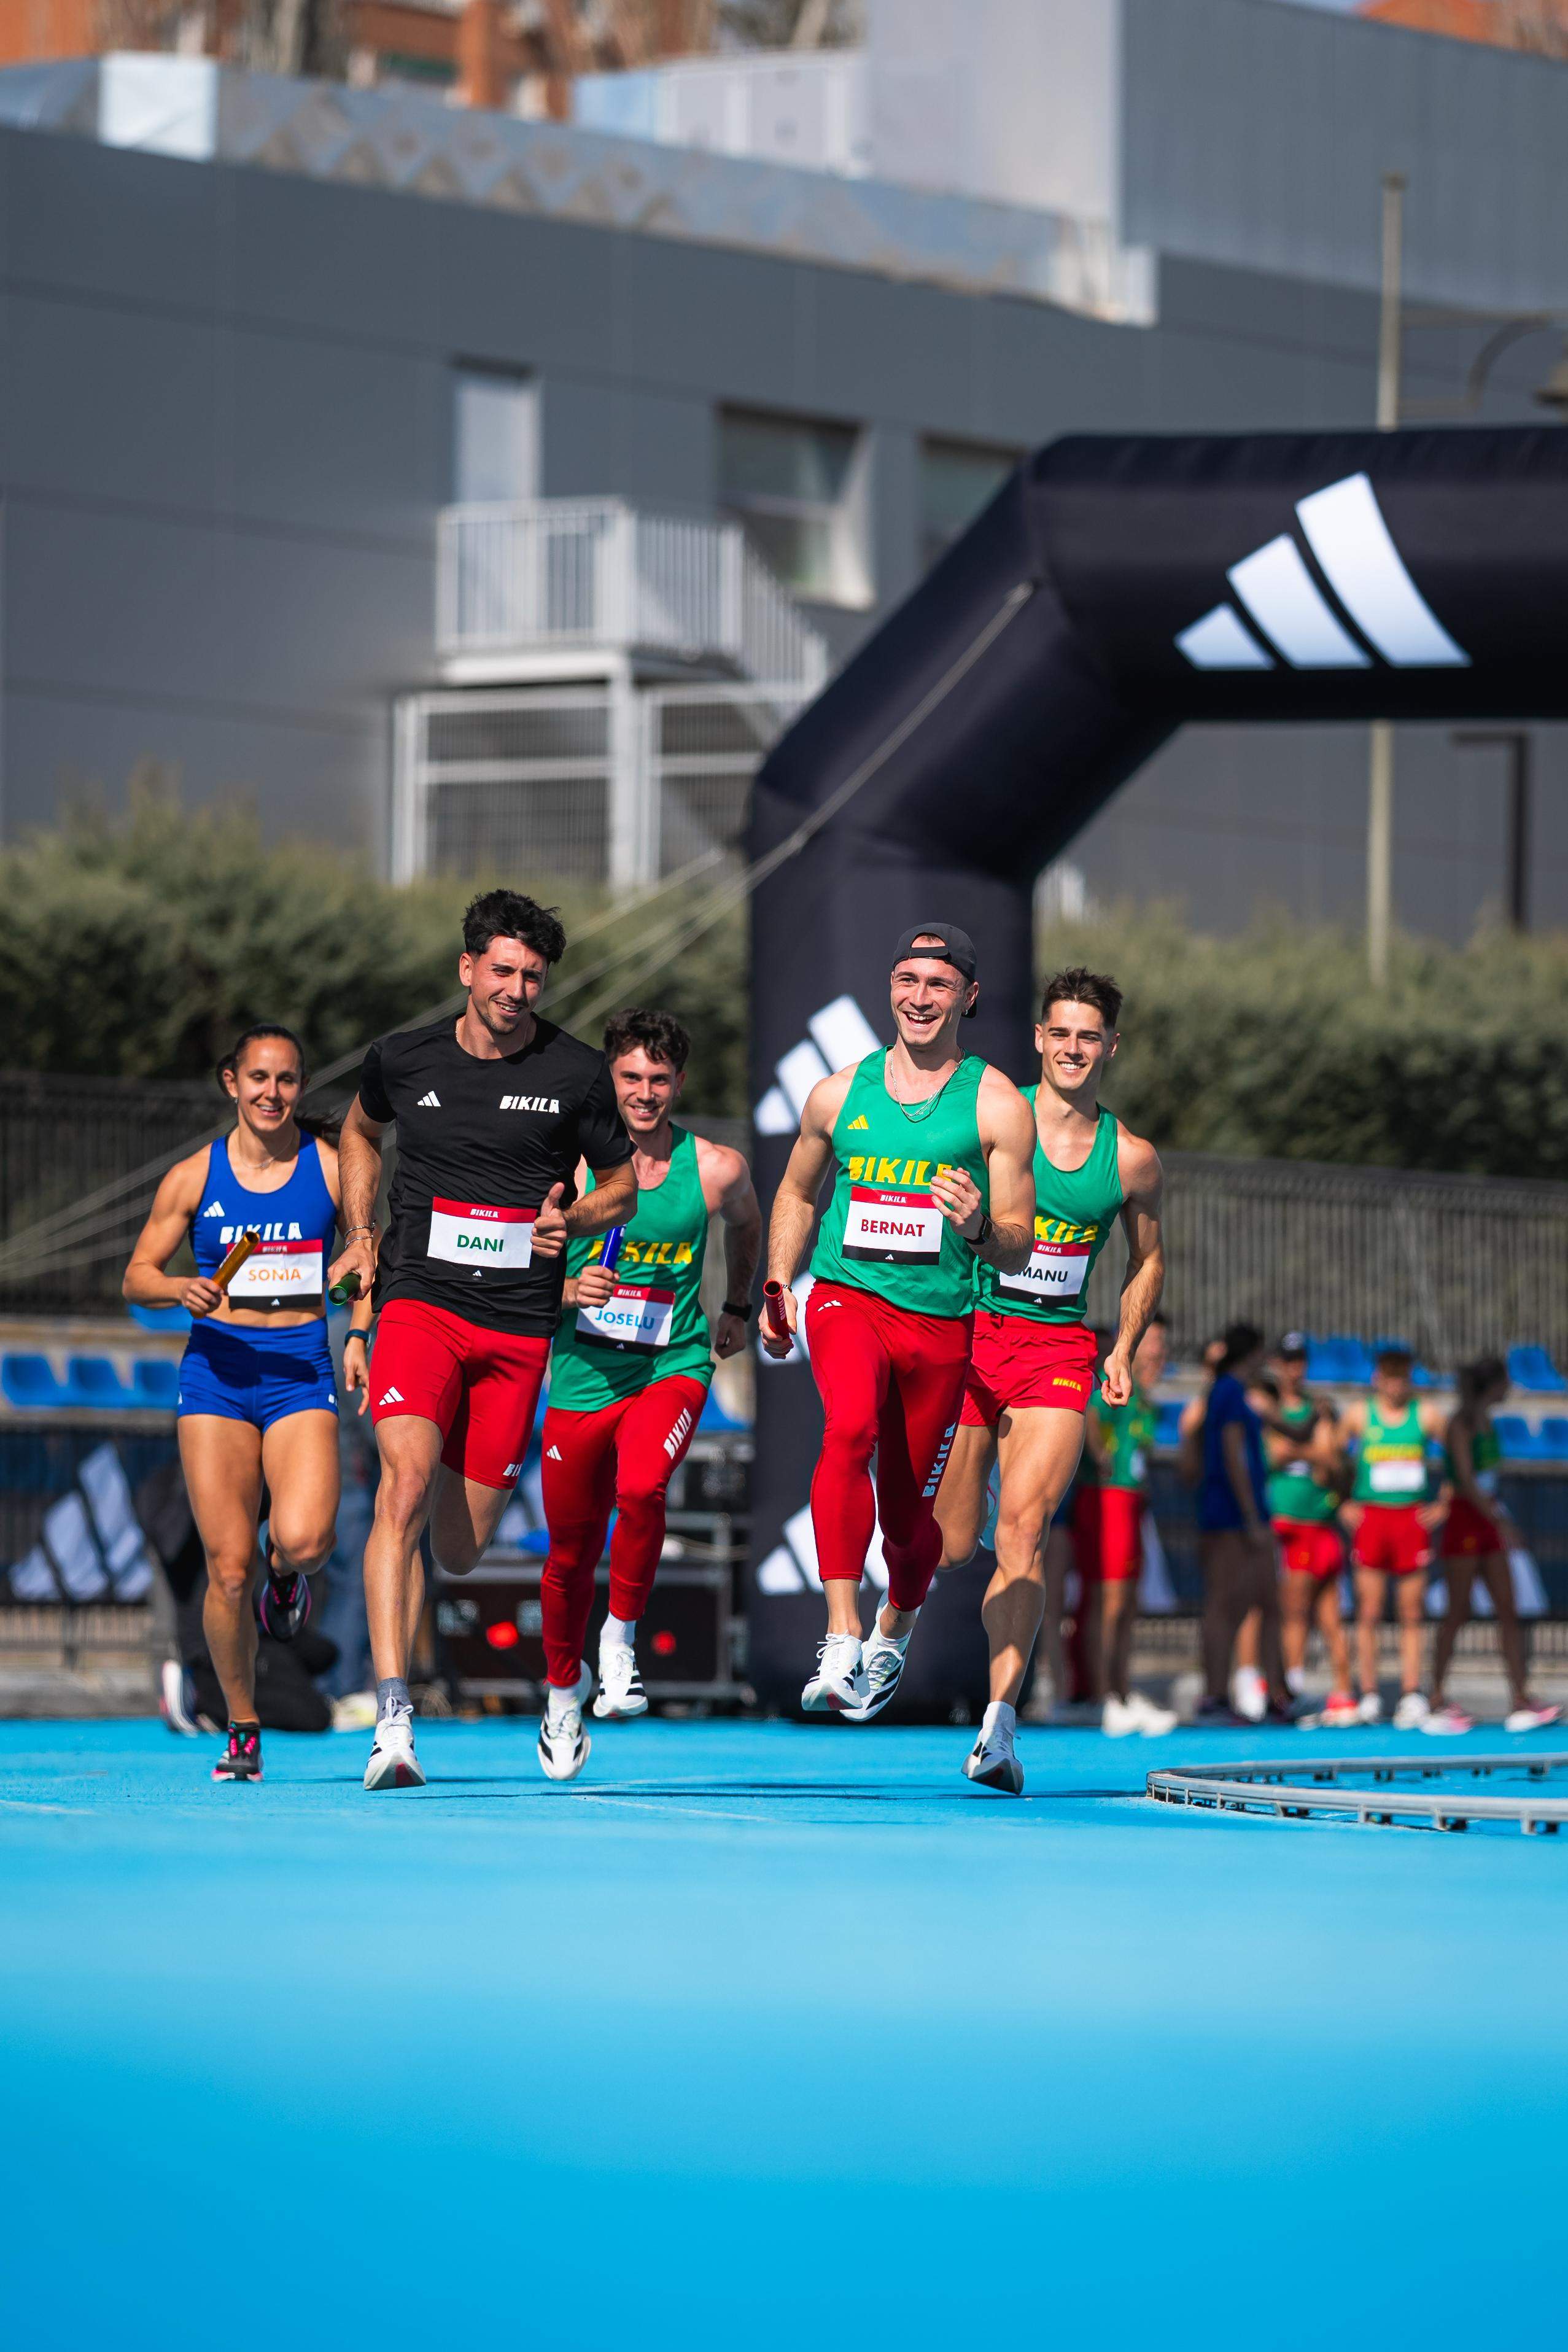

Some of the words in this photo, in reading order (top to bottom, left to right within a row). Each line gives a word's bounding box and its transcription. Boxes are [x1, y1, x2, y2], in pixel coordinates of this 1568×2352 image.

[499, 1095, 559, 1114] BIKILA
[880, 1194, 906, 1204] BIKILA
[470, 1208, 499, 1218] BIKILA
[861, 1219, 925, 1237] BERNAT
[1034, 1216, 1098, 1243] KILA
[457, 1234, 504, 1252] DANI
[588, 1240, 693, 1264] BKILA
[1038, 1244, 1062, 1254] BIKILA
[248, 1268, 301, 1281] SONIA
[1018, 1267, 1068, 1283] MANU
[617, 1289, 642, 1297] BIKILA
[595, 1310, 655, 1330] JOSELU
[1052, 1378, 1082, 1392] BIKILA
[664, 1408, 692, 1460] BIKILA
[922, 1422, 956, 1497] BIKILA
